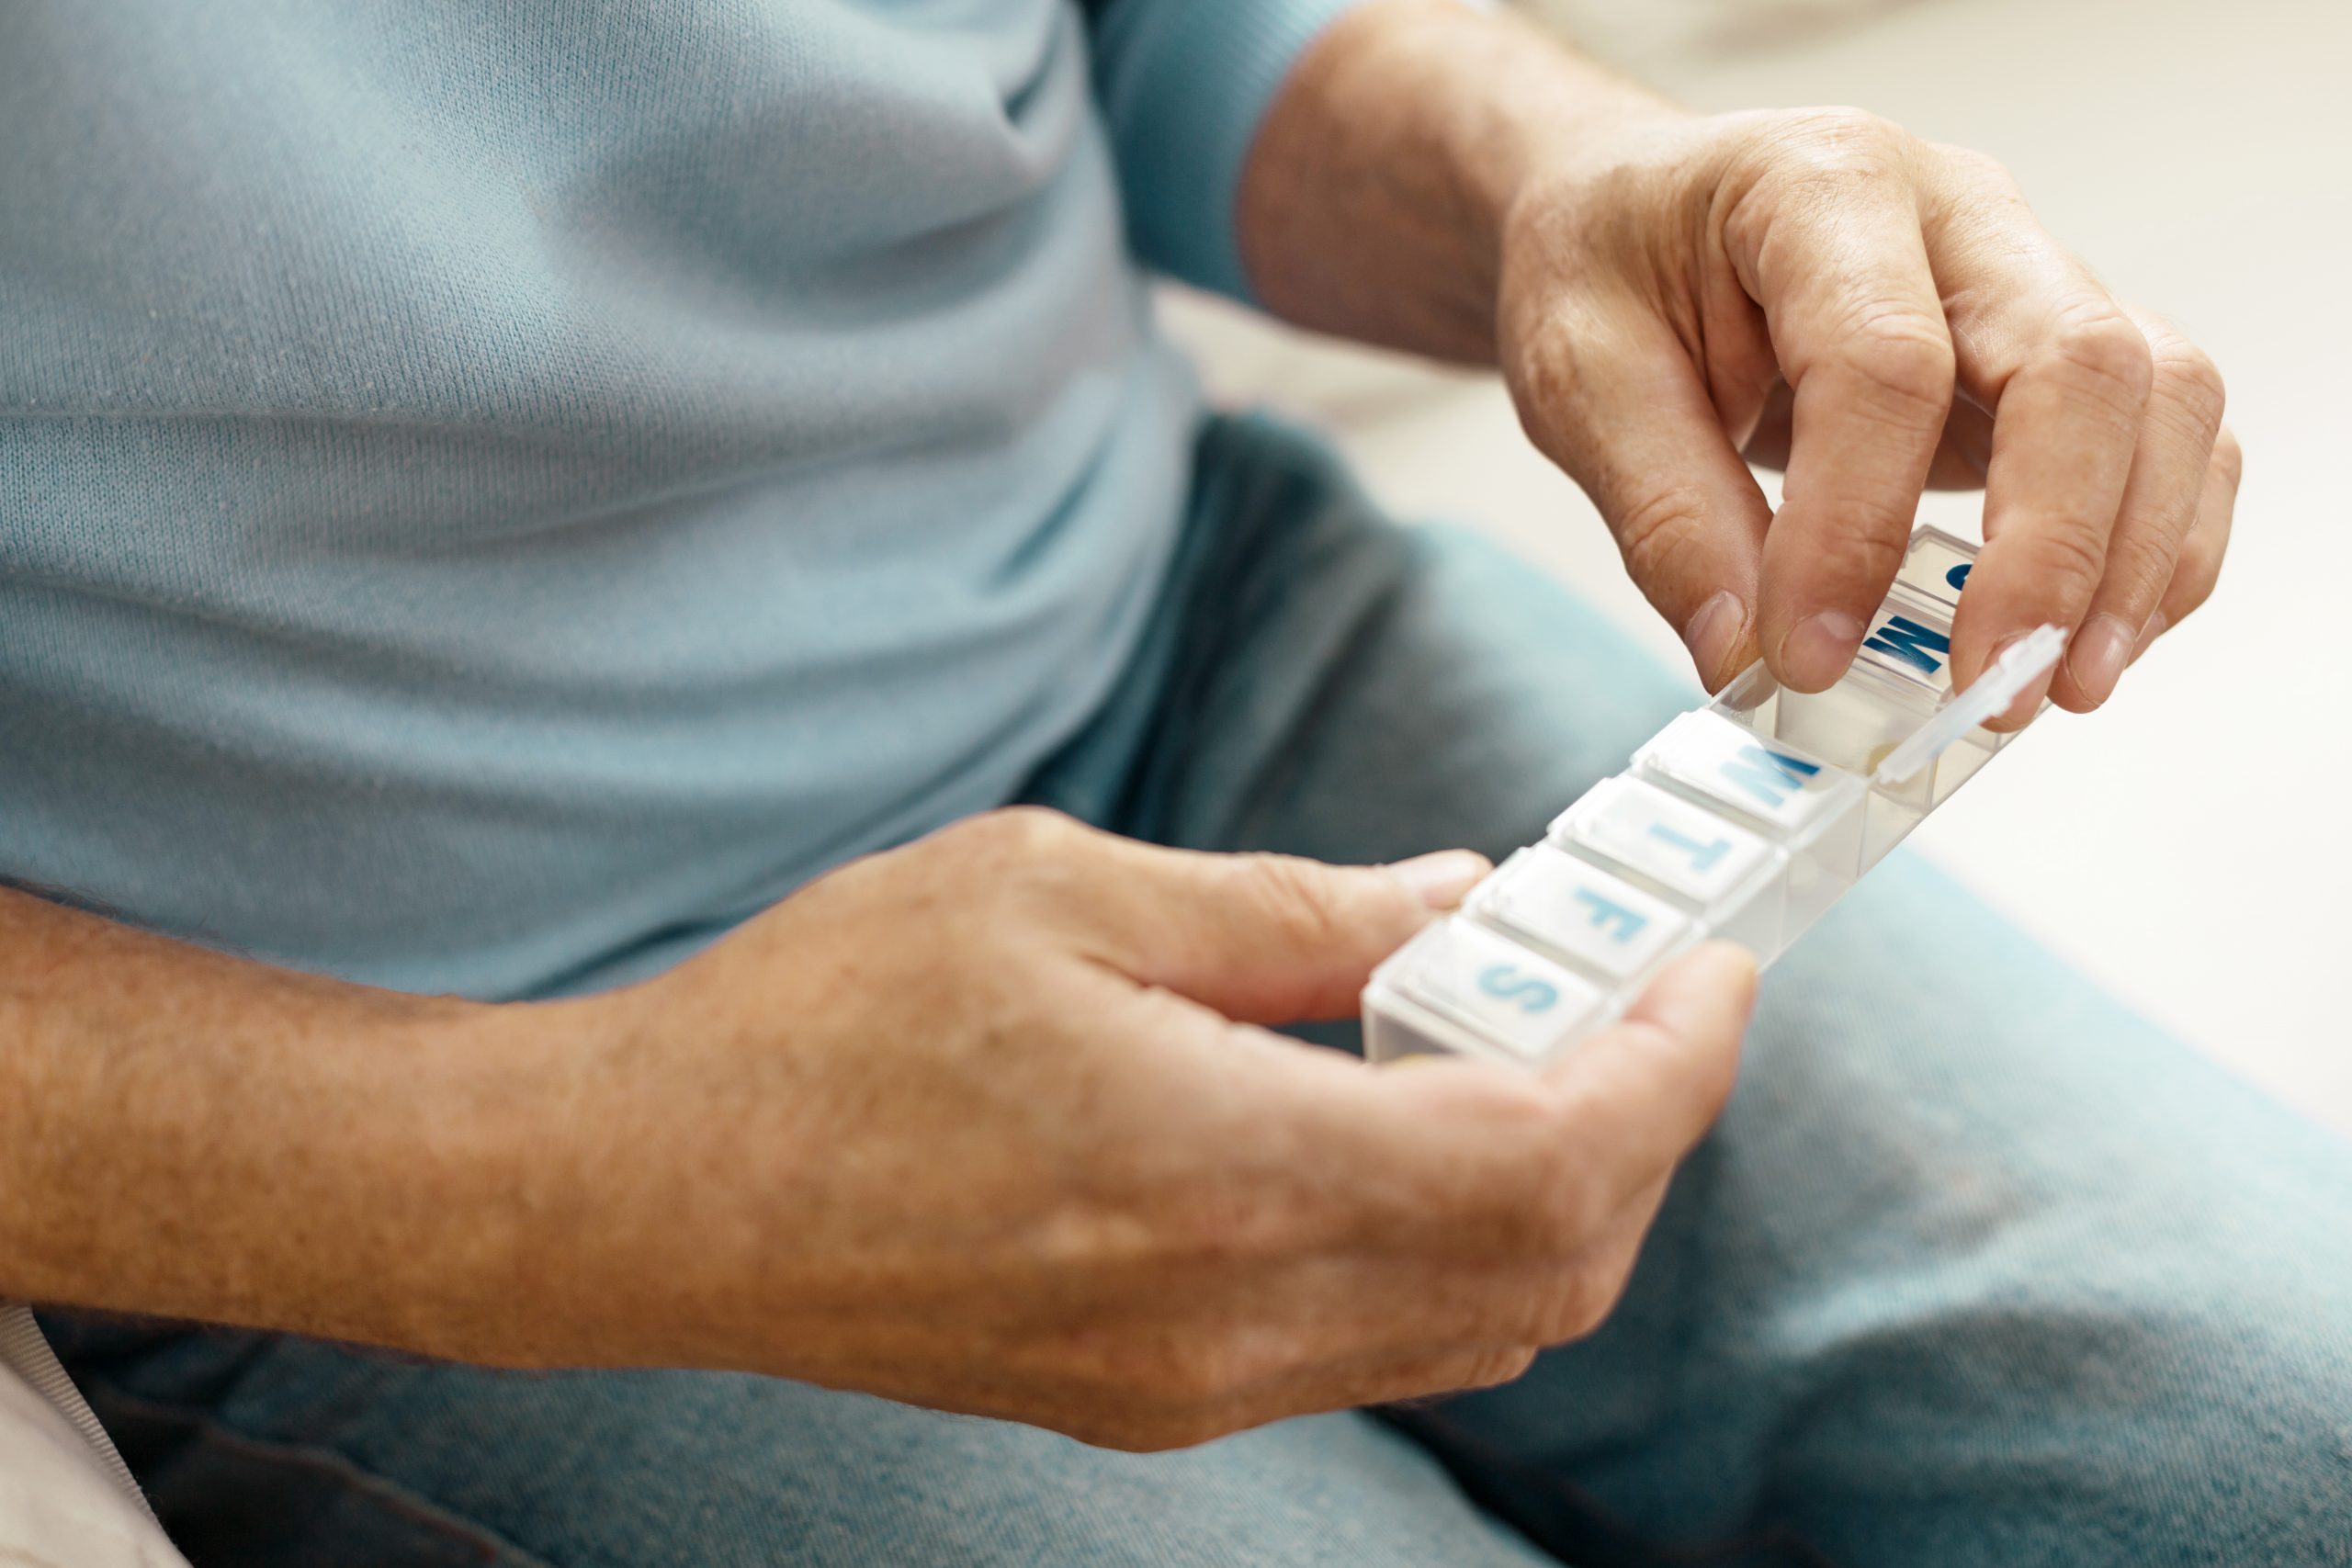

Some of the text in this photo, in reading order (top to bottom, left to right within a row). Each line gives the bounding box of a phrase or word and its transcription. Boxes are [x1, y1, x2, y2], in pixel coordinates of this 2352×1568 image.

[1862, 615, 1950, 674] M
[1718, 744, 1821, 808] W
[1648, 822, 1733, 871] T
[1575, 886, 1648, 943] F
[1477, 964, 1559, 1013] S
